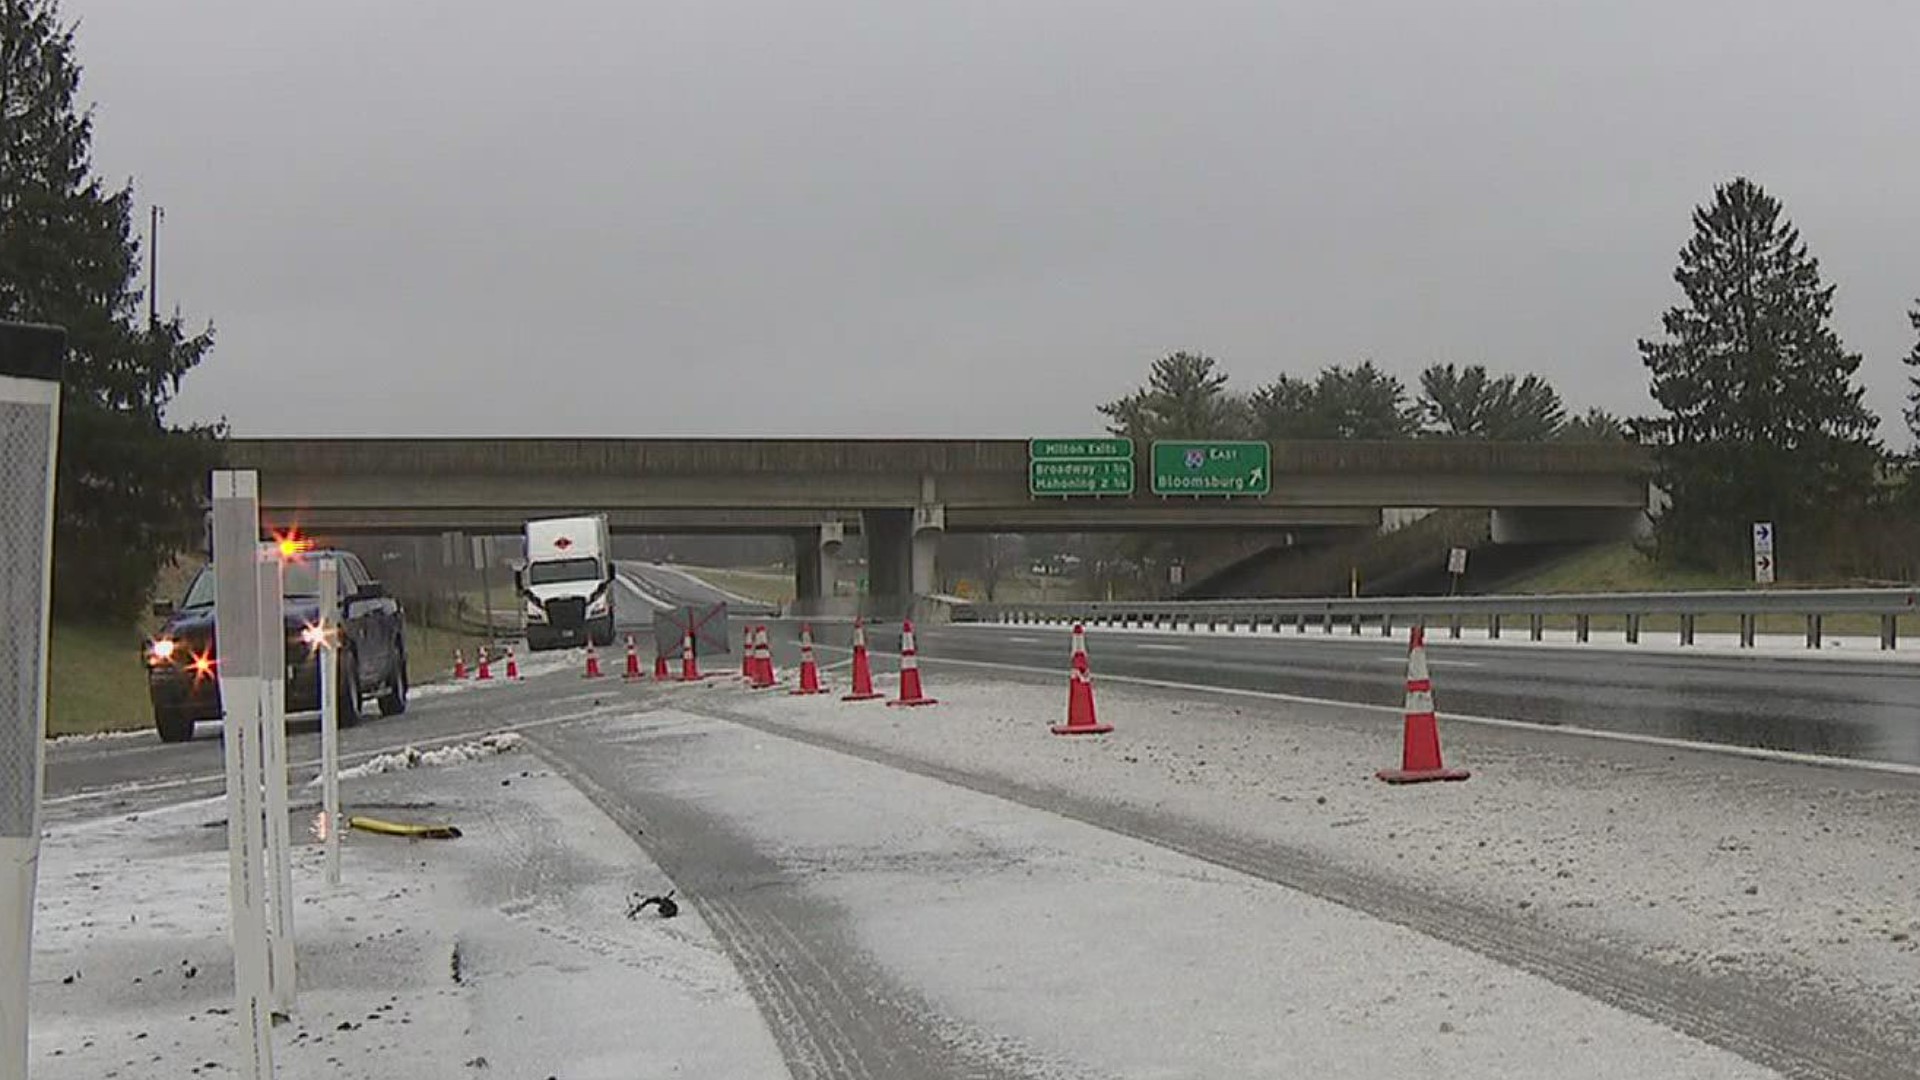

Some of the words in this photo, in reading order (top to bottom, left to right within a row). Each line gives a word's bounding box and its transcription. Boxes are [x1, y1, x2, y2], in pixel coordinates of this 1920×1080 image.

[1046, 444, 1084, 455] Milton
[1089, 443, 1117, 455] Exits
[1210, 448, 1238, 460] EAST
[1036, 464, 1095, 477] Broadway
[1036, 478, 1096, 490] Mahoning
[1158, 474, 1244, 491] Bloomsburg
